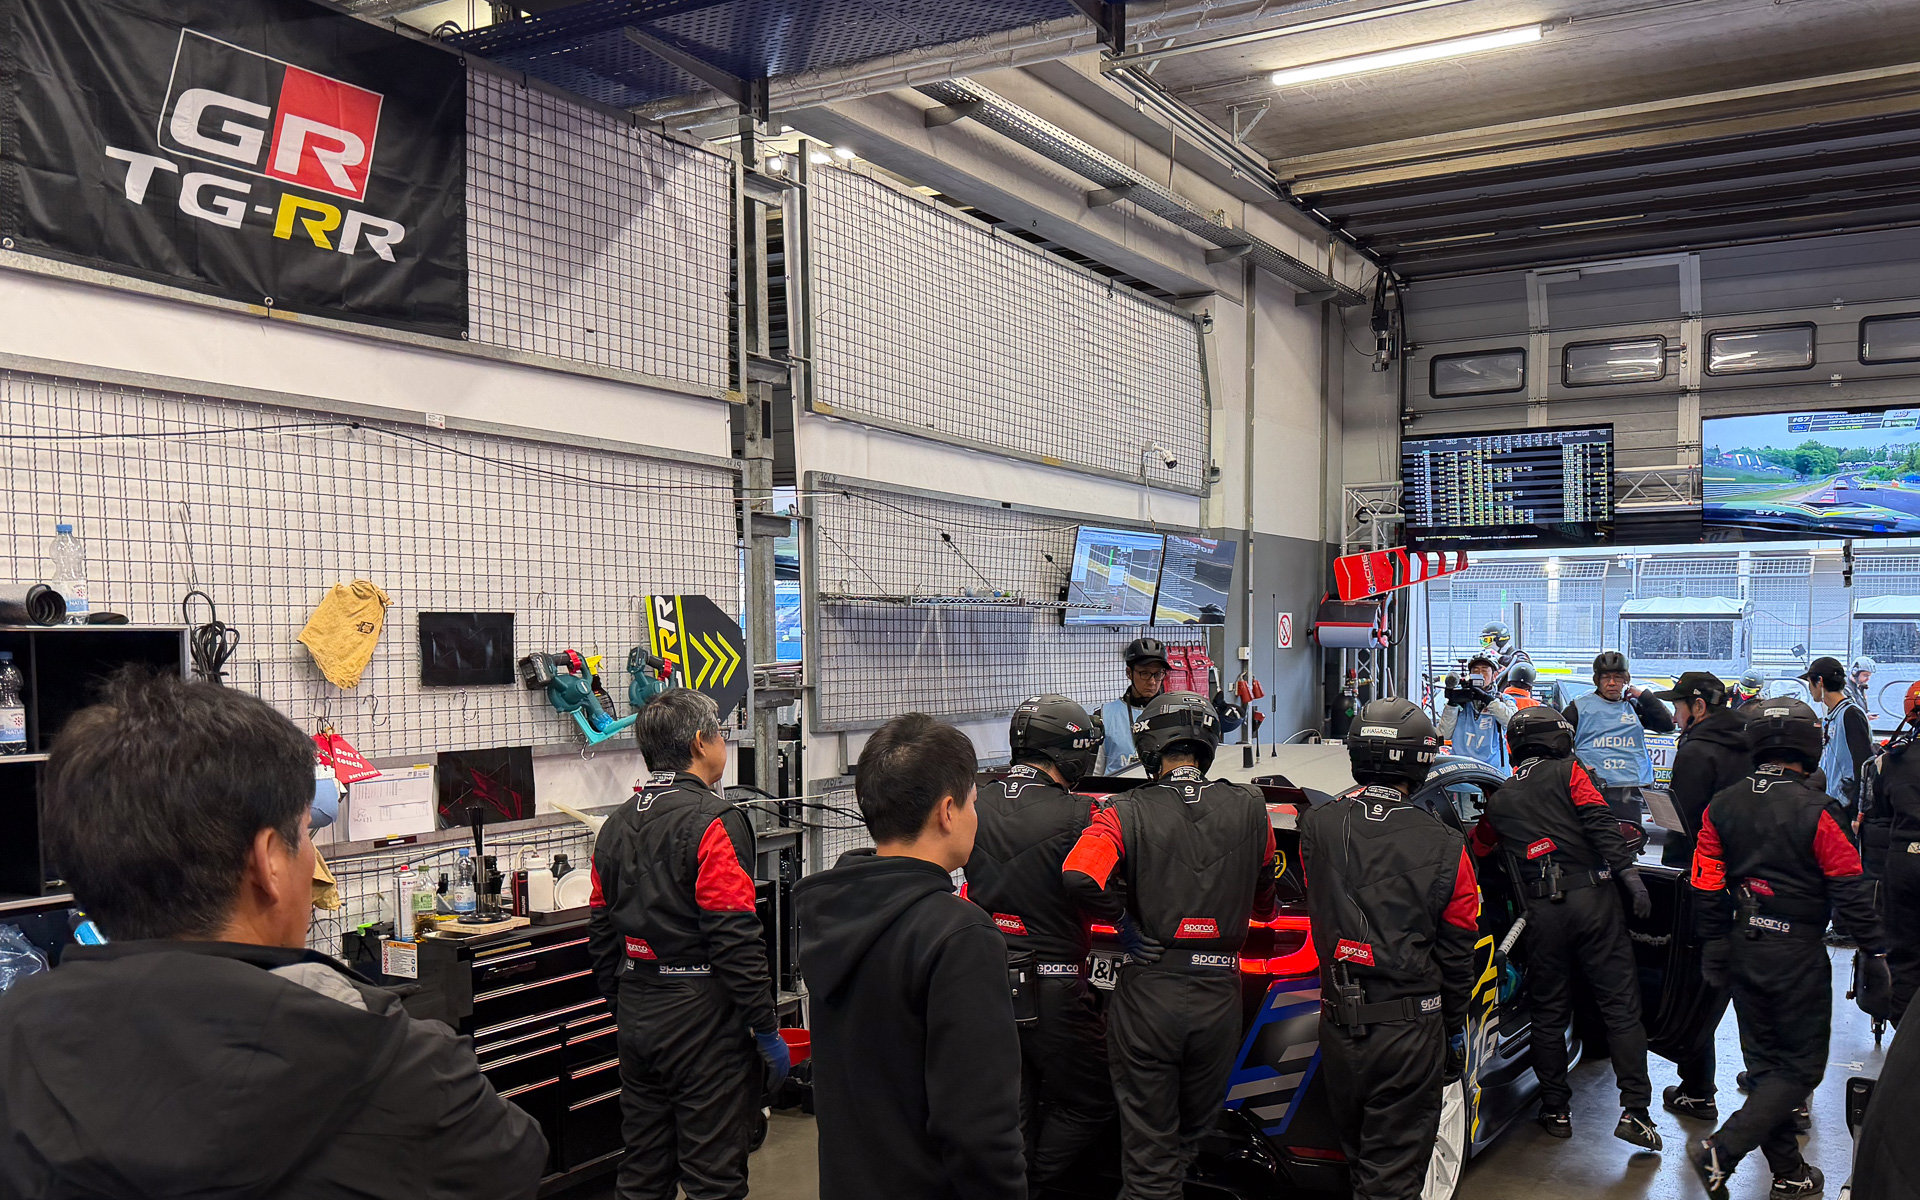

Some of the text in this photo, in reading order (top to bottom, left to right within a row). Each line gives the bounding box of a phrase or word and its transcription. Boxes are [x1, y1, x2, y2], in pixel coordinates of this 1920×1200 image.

[169, 88, 366, 191] GR
[105, 145, 405, 263] TG-RR
[1361, 554, 1374, 587] KCMG
[1592, 736, 1635, 748] MEDIA
[335, 748, 360, 760] Don't
[337, 757, 363, 769] touch
[1603, 758, 1626, 769] 812
[1656, 770, 1672, 779] DEK
[1184, 924, 1214, 932] sparco
[1191, 954, 1236, 966] sparco
[1421, 995, 1441, 1011] spar
